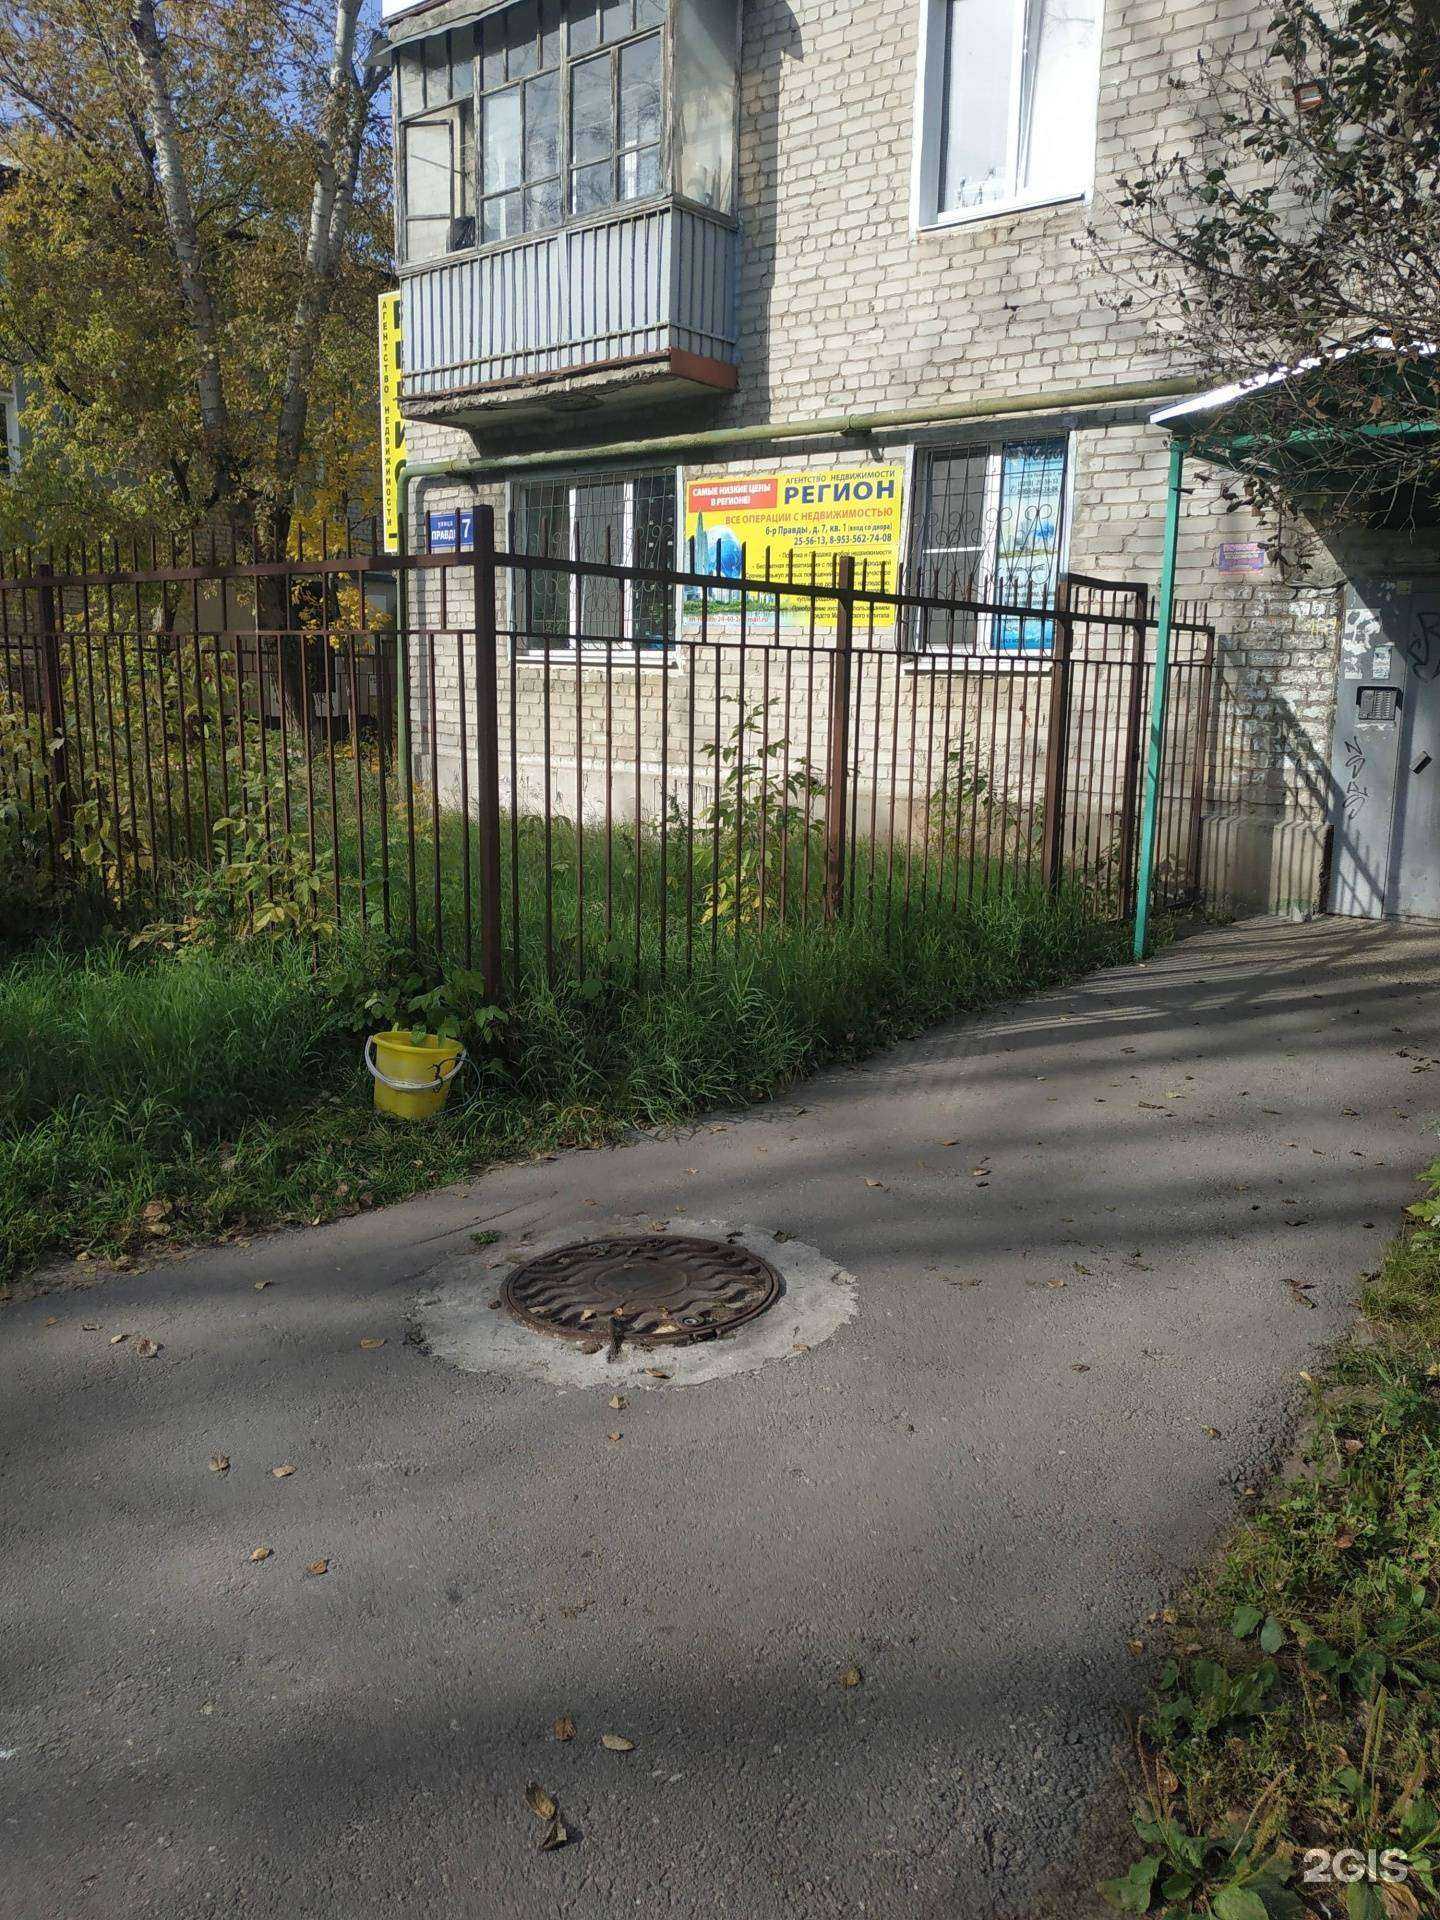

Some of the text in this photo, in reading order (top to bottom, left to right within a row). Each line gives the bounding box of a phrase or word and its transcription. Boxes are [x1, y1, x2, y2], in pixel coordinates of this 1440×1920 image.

[384, 406, 392, 526] НЕДВИЖИМОСТИ
[785, 470, 895, 484] АГЕНТСТВО НЕДВИЖИМОСТИ
[692, 483, 771, 497] САМЫЕ НИЗКИЕ ЦЕНЫ
[784, 479, 895, 505] РЕГИОН
[710, 496, 751, 506] В РЕГИОНЕ!
[725, 507, 893, 525] ВСЕ ОПЕРАЦИИ С НЕДВИЖИМОСТЬЮ
[431, 518, 471, 541] ПРАВД 7
[765, 526, 777, 537] б-р
[829, 524, 841, 532] кв.
[829, 533, 892, 545] 8-953-562-74-08
